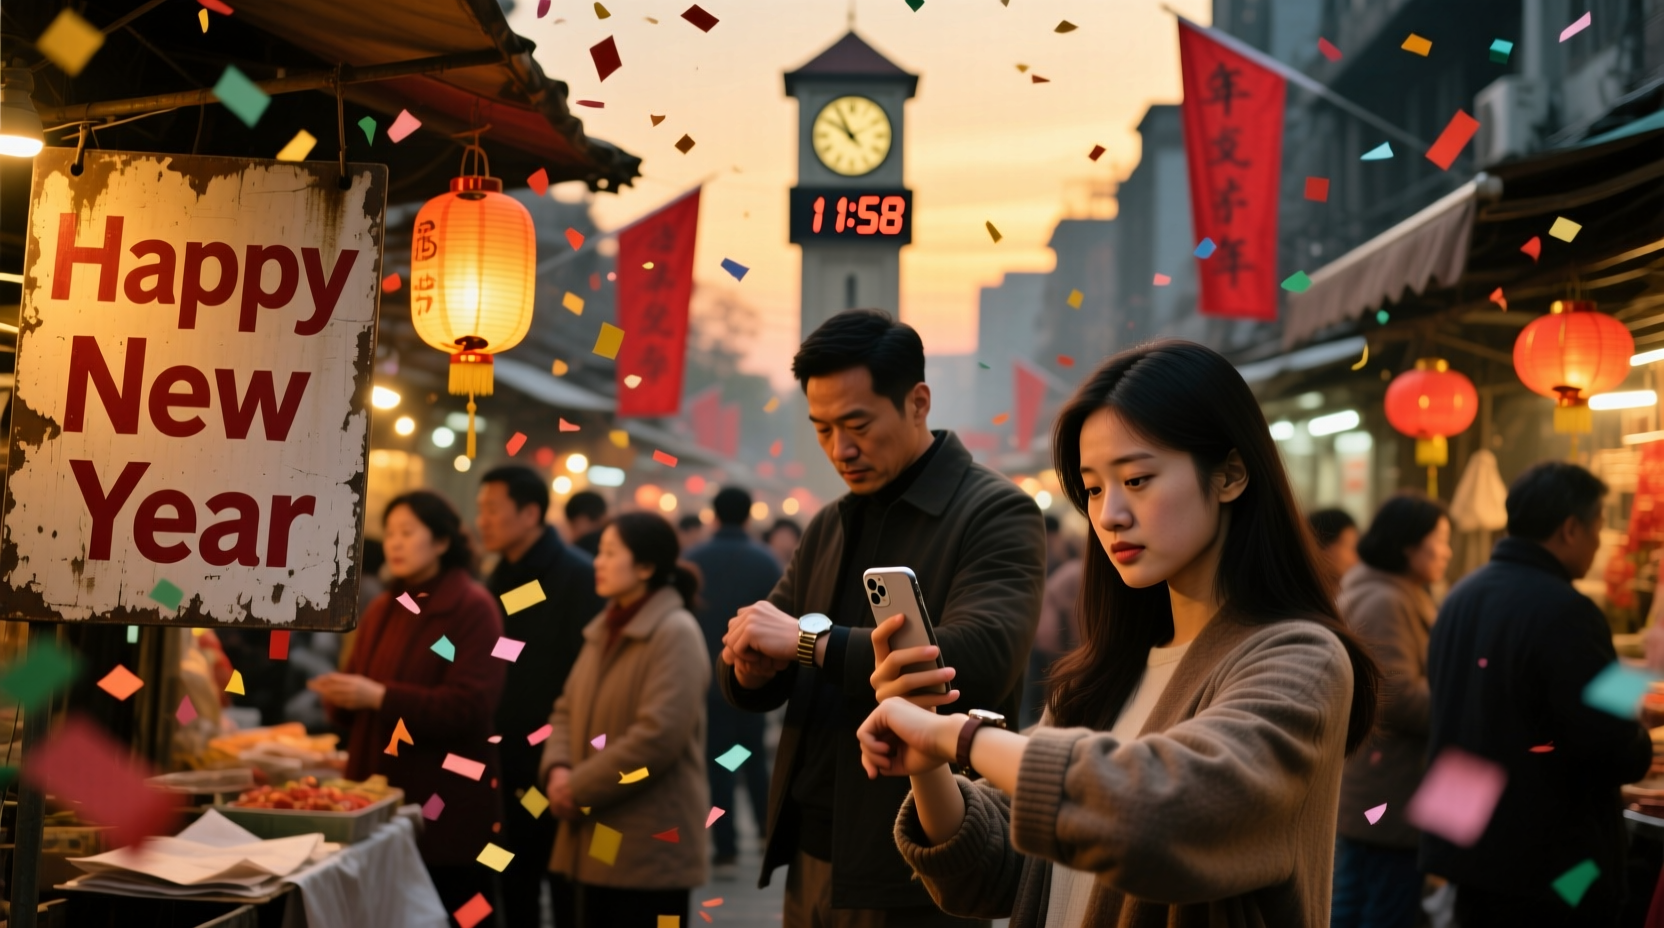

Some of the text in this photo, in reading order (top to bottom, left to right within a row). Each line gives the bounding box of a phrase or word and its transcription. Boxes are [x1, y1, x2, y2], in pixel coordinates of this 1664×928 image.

[811, 195, 906, 235] 11:58
[51, 213, 359, 336] Happy
[63, 335, 311, 442] New
[69, 459, 316, 568] Year
